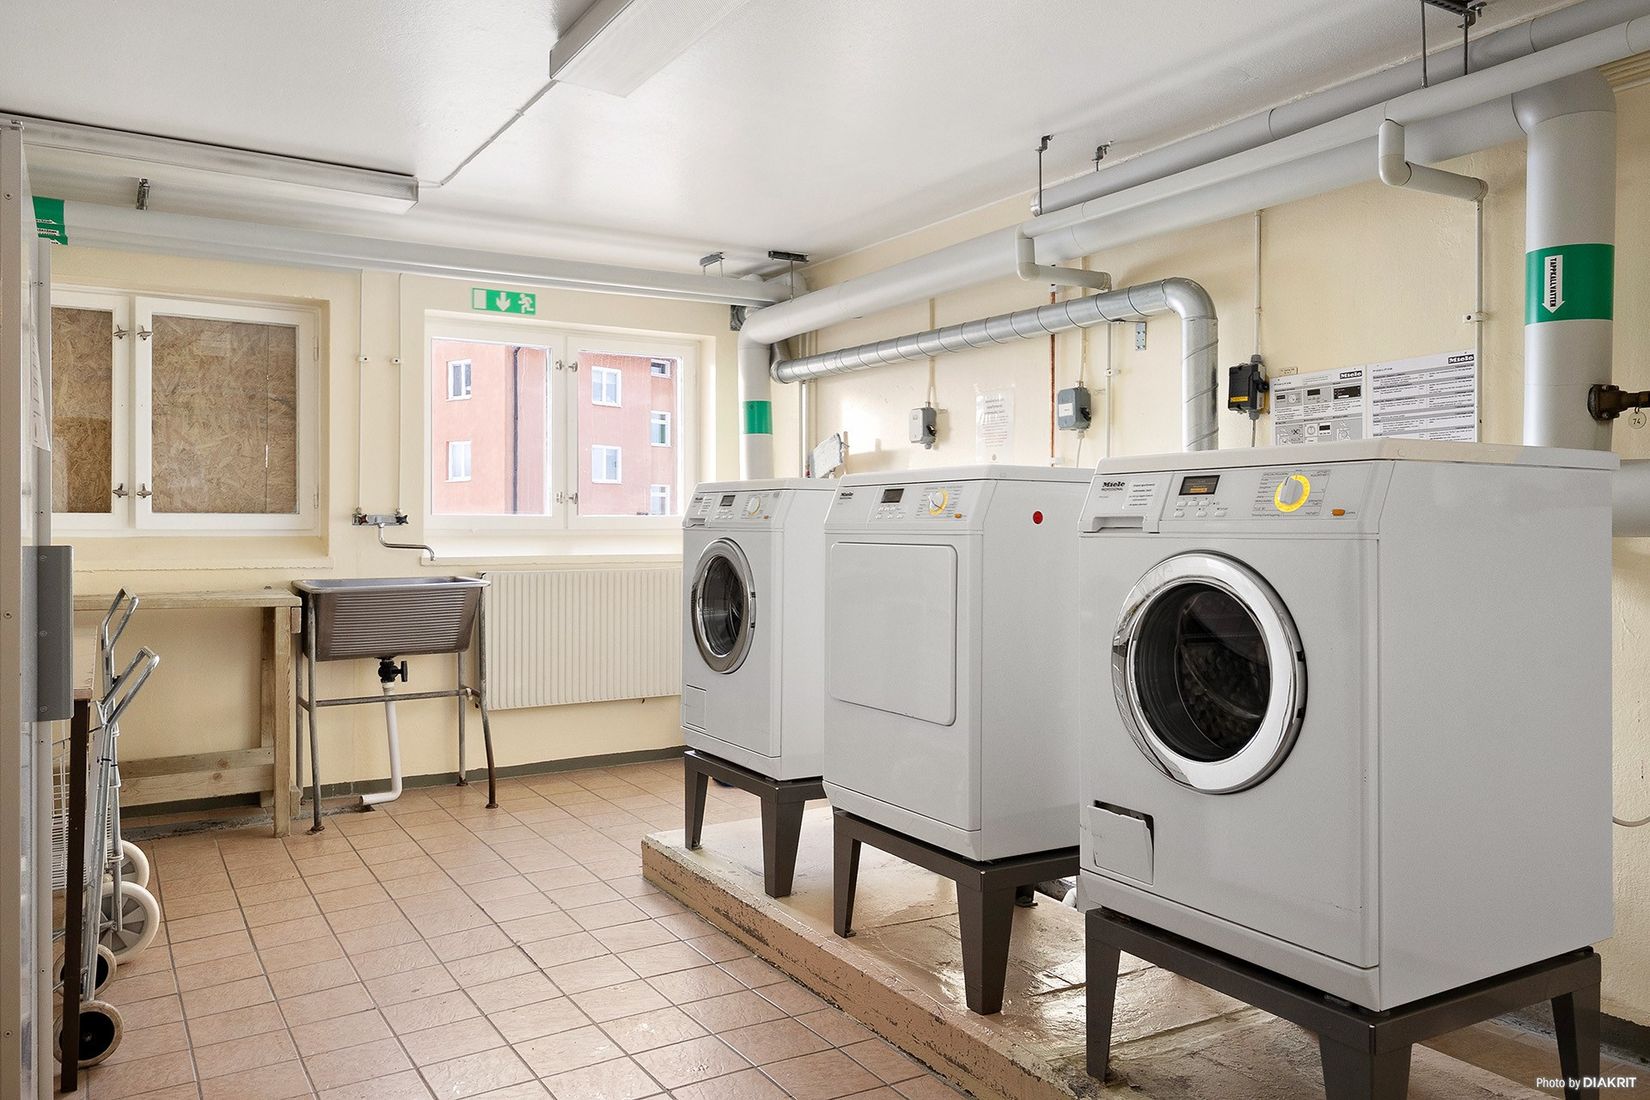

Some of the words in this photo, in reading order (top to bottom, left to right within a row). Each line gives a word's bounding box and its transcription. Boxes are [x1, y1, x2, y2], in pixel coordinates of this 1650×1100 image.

[1549, 257, 1557, 308] TAPPKALLVATTEN
[1448, 355, 1474, 364] Miele
[1340, 371, 1362, 379] Miele
